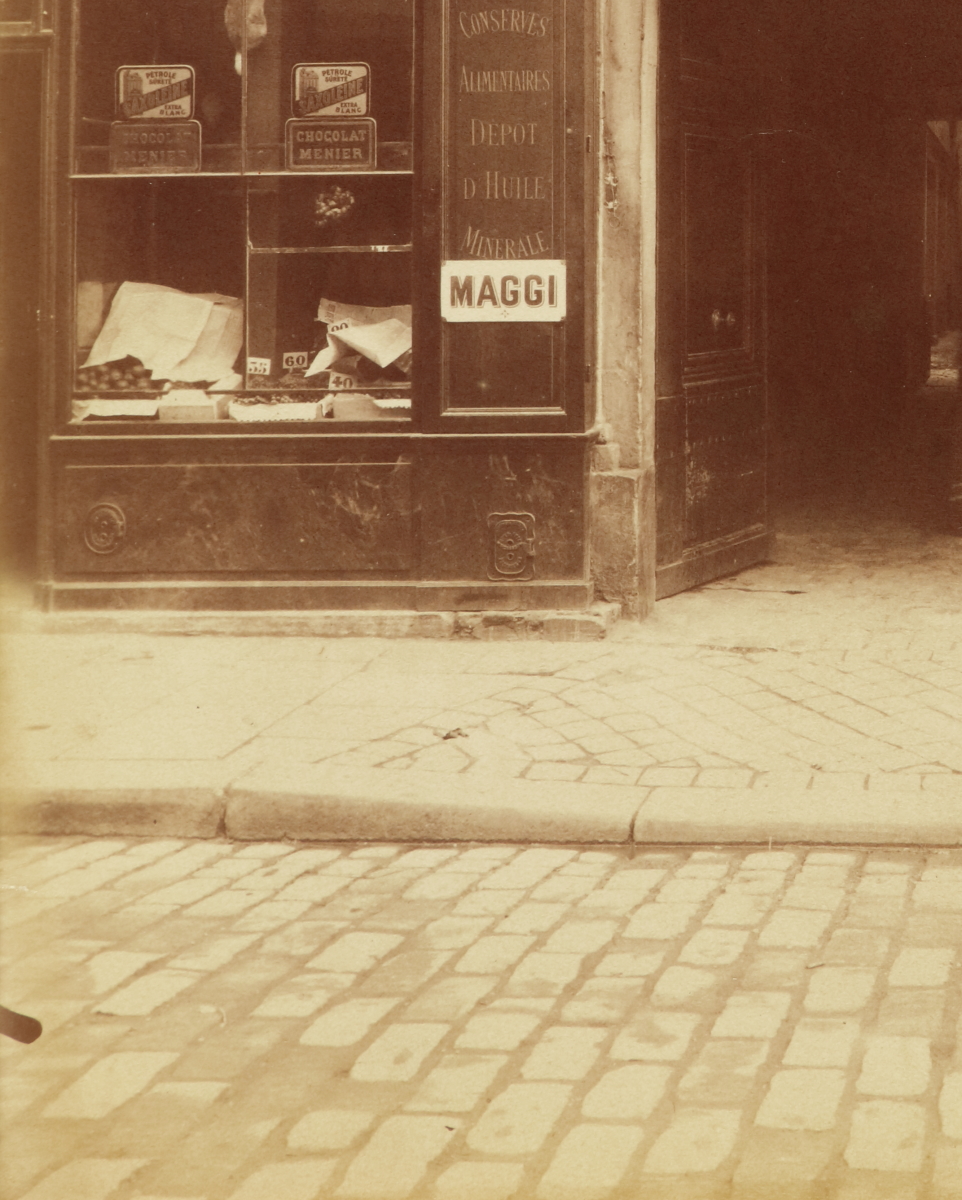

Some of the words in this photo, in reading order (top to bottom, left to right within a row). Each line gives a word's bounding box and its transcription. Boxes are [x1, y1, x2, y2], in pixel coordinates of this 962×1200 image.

[459, 9, 550, 38] CONSERVES
[459, 65, 550, 93] ALIMENTAIRES
[296, 130, 367, 143] CHOCOLAT
[299, 148, 363, 160] MENIER
[450, 274, 558, 309] MAGGI
[285, 354, 306, 367] 60
[331, 376, 353, 389] 40
